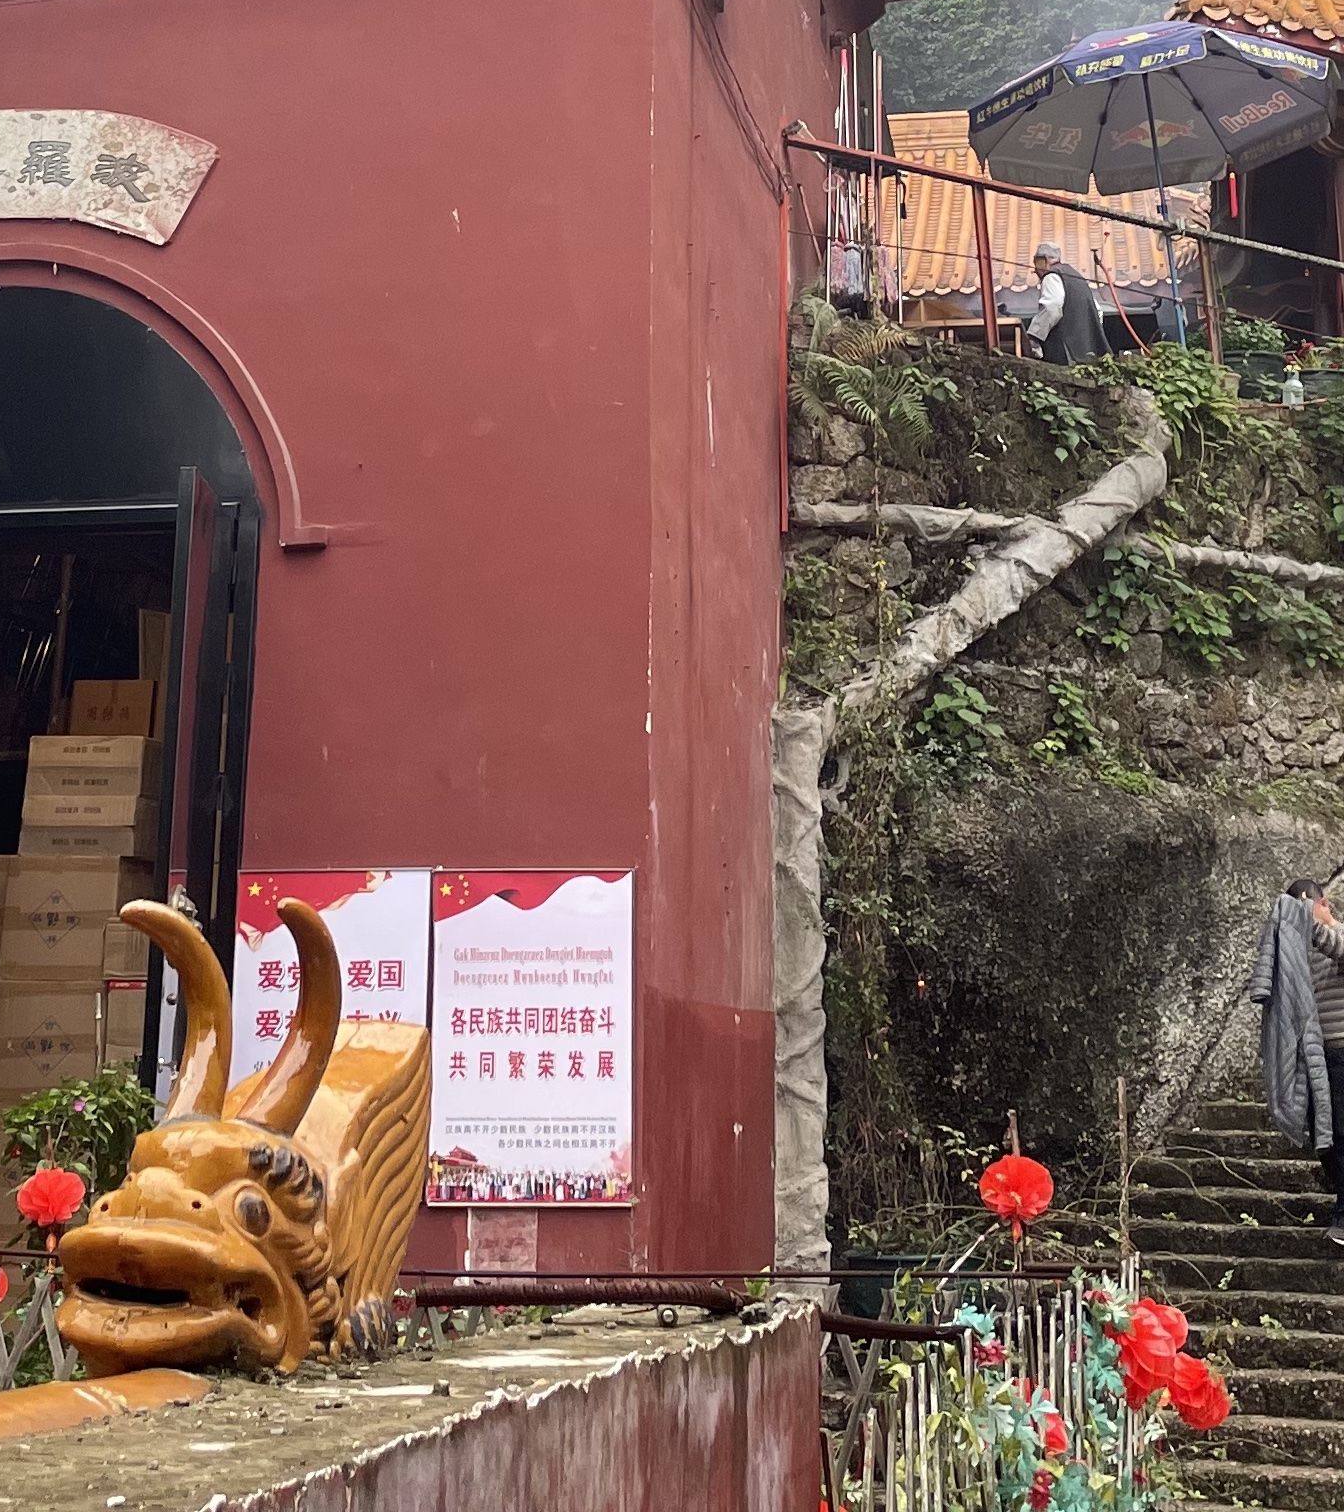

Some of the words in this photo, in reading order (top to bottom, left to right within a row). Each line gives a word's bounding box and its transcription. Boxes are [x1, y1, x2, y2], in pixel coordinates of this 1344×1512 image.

[347, 959, 404, 989] 爱国
[451, 1006, 615, 1036] 各民族共同团结奋斗
[449, 1050, 616, 1080] 共同繁荣发展
